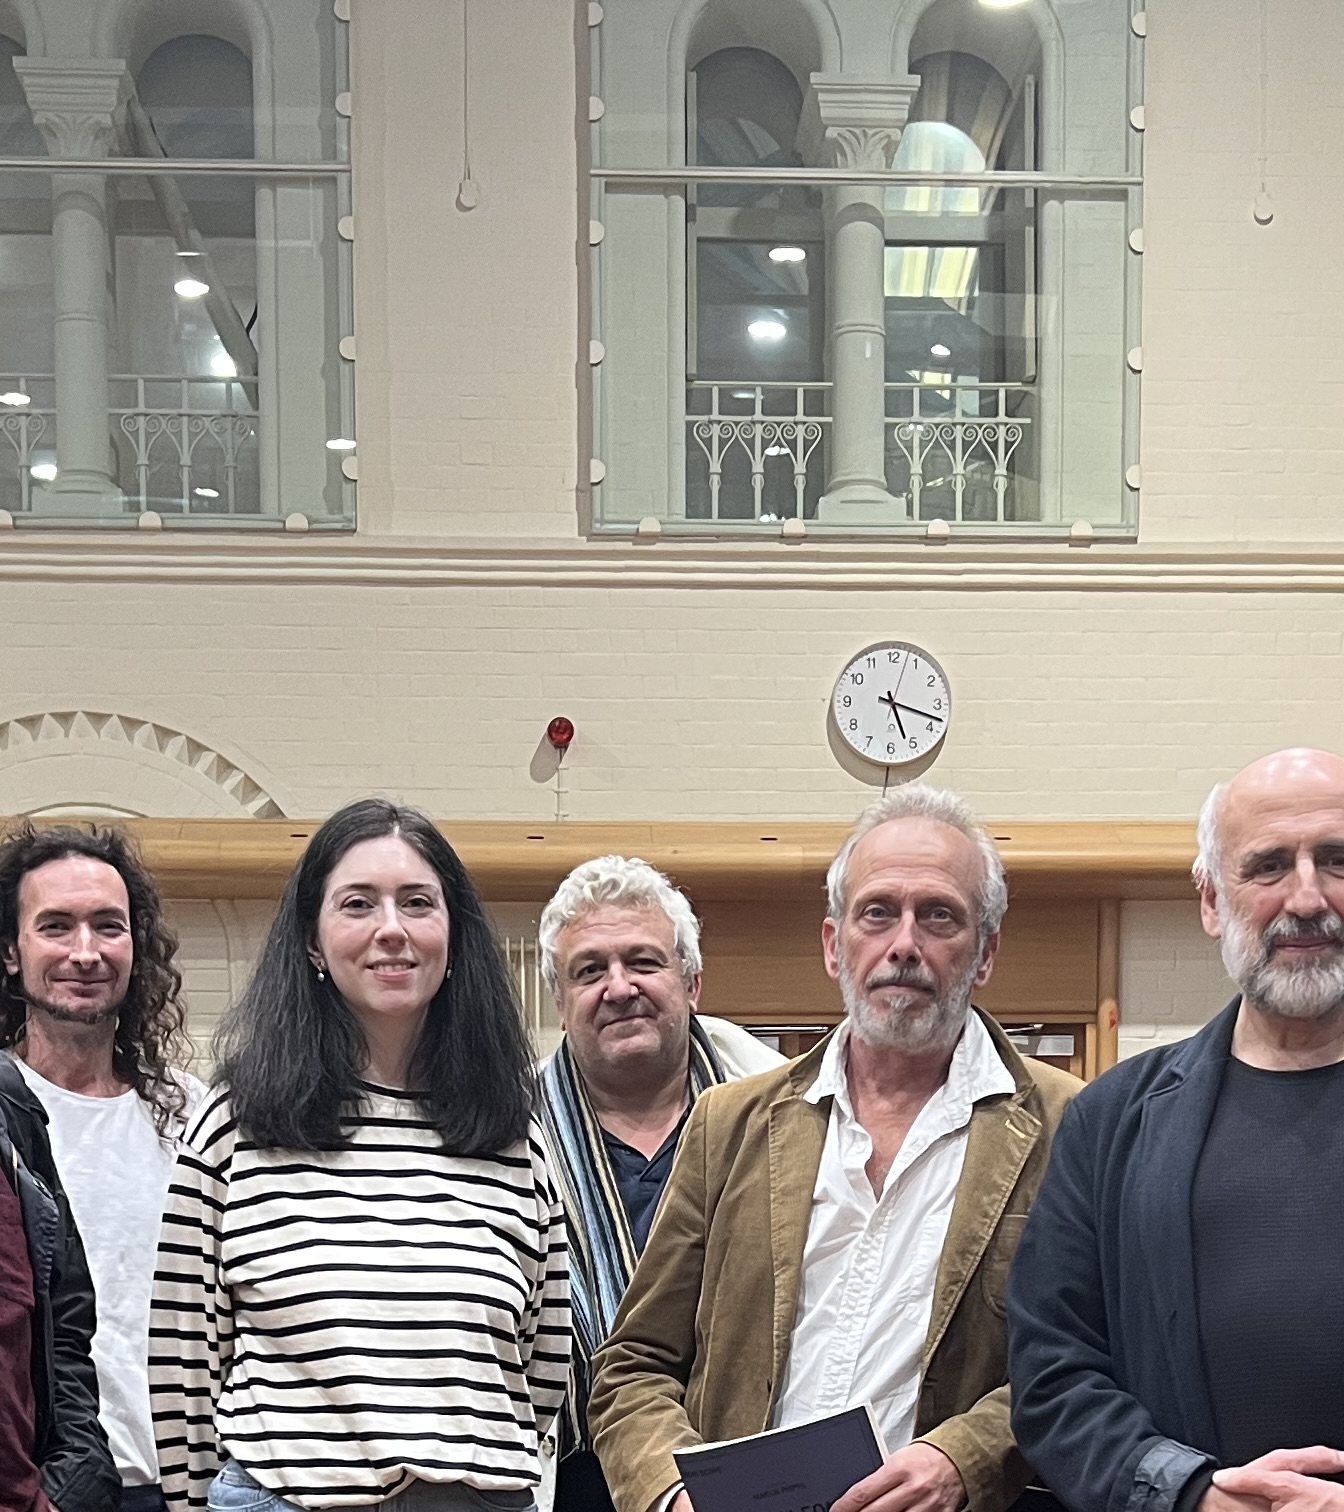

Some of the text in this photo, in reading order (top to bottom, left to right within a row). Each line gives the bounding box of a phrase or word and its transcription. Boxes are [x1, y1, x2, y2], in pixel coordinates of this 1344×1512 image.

[866, 657, 876, 669] 11
[887, 651, 901, 664] 12
[912, 658, 918, 669] 1
[850, 672, 864, 686] 10
[926, 675, 936, 688] 2
[842, 695, 852, 708] 9
[932, 698, 942, 711] 3
[849, 718, 858, 731] 8
[925, 721, 934, 733] 4
[865, 735, 874, 748] 7
[908, 737, 918, 750] 5
[886, 742, 896, 755] 6
